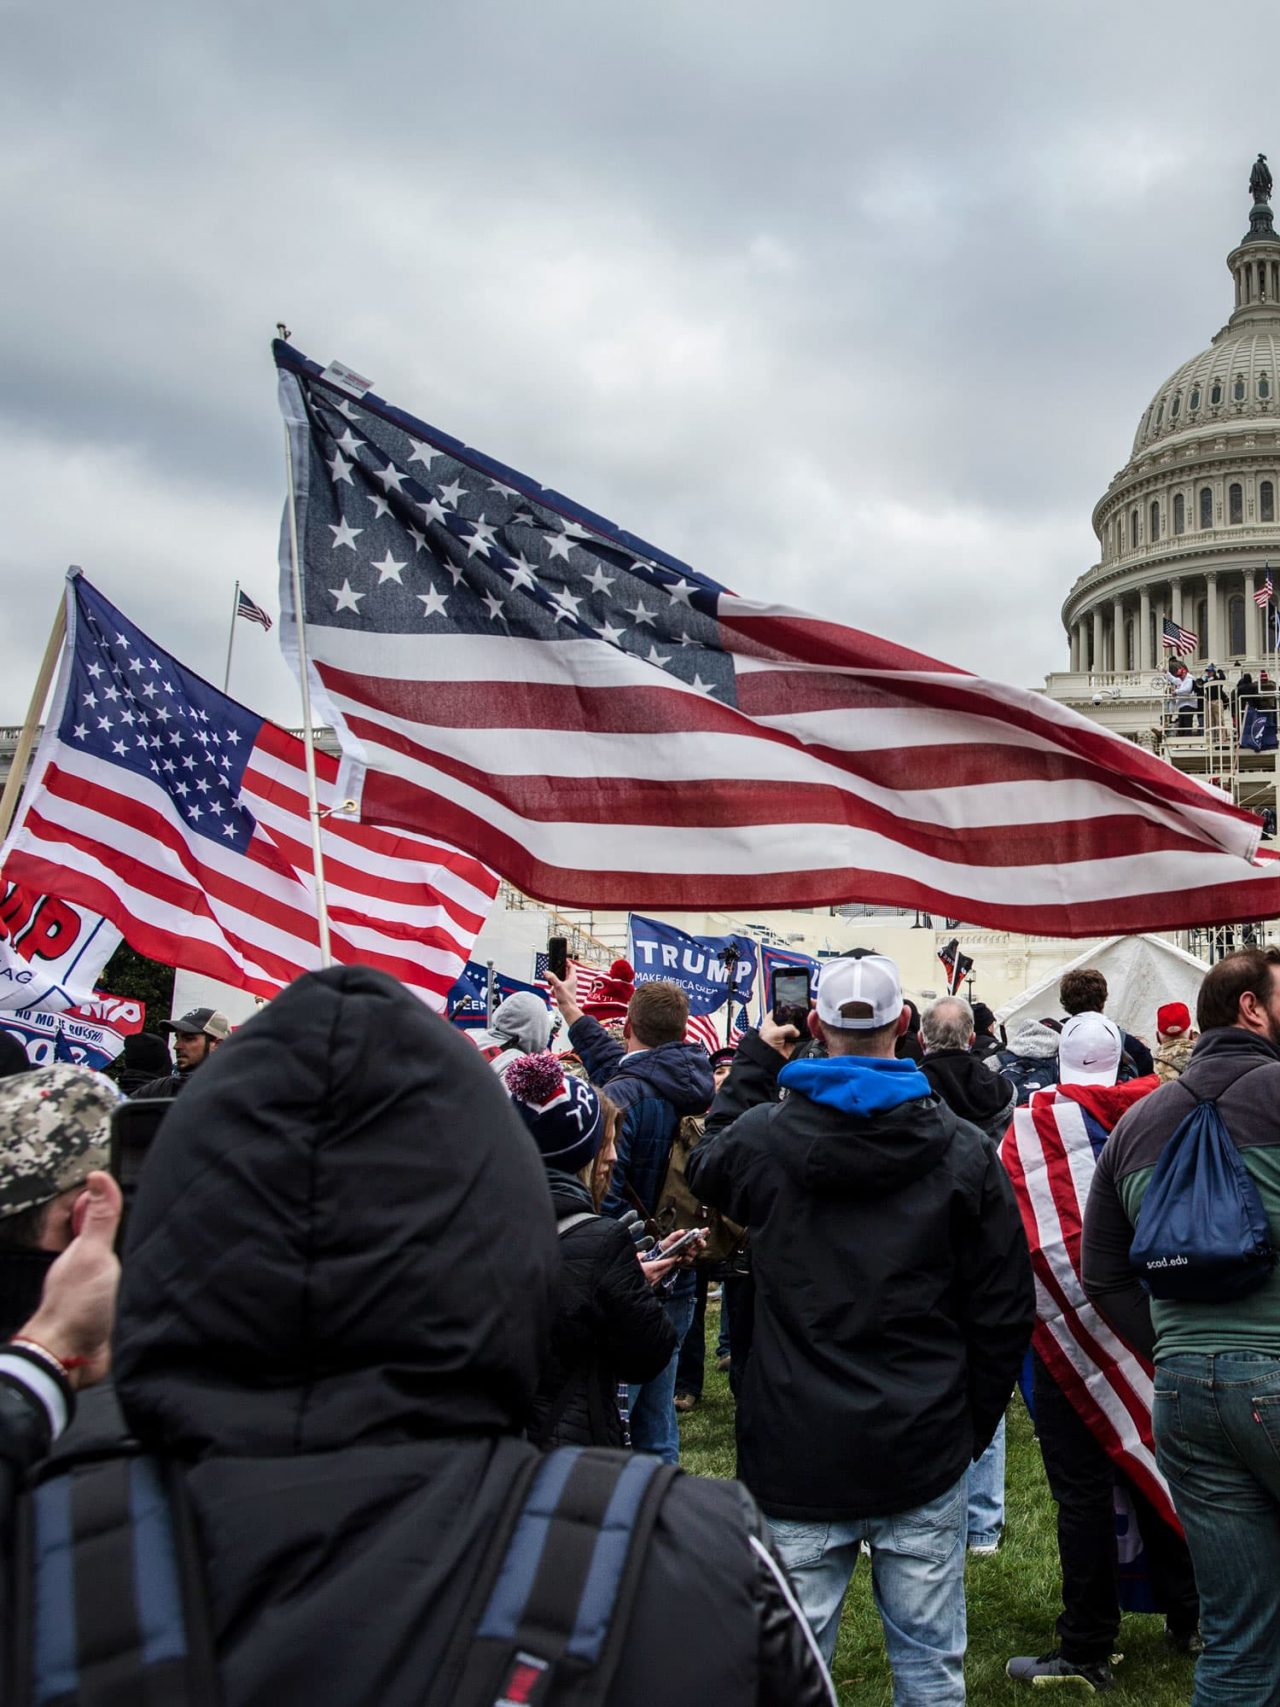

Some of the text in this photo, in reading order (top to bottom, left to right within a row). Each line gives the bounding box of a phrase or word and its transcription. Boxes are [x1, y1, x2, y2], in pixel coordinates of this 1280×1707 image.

[636, 940, 752, 984] TRUMP
[635, 971, 661, 982] MAKE
[453, 1000, 487, 1011] KEEP
[1146, 1254, 1188, 1269] scad.edu
